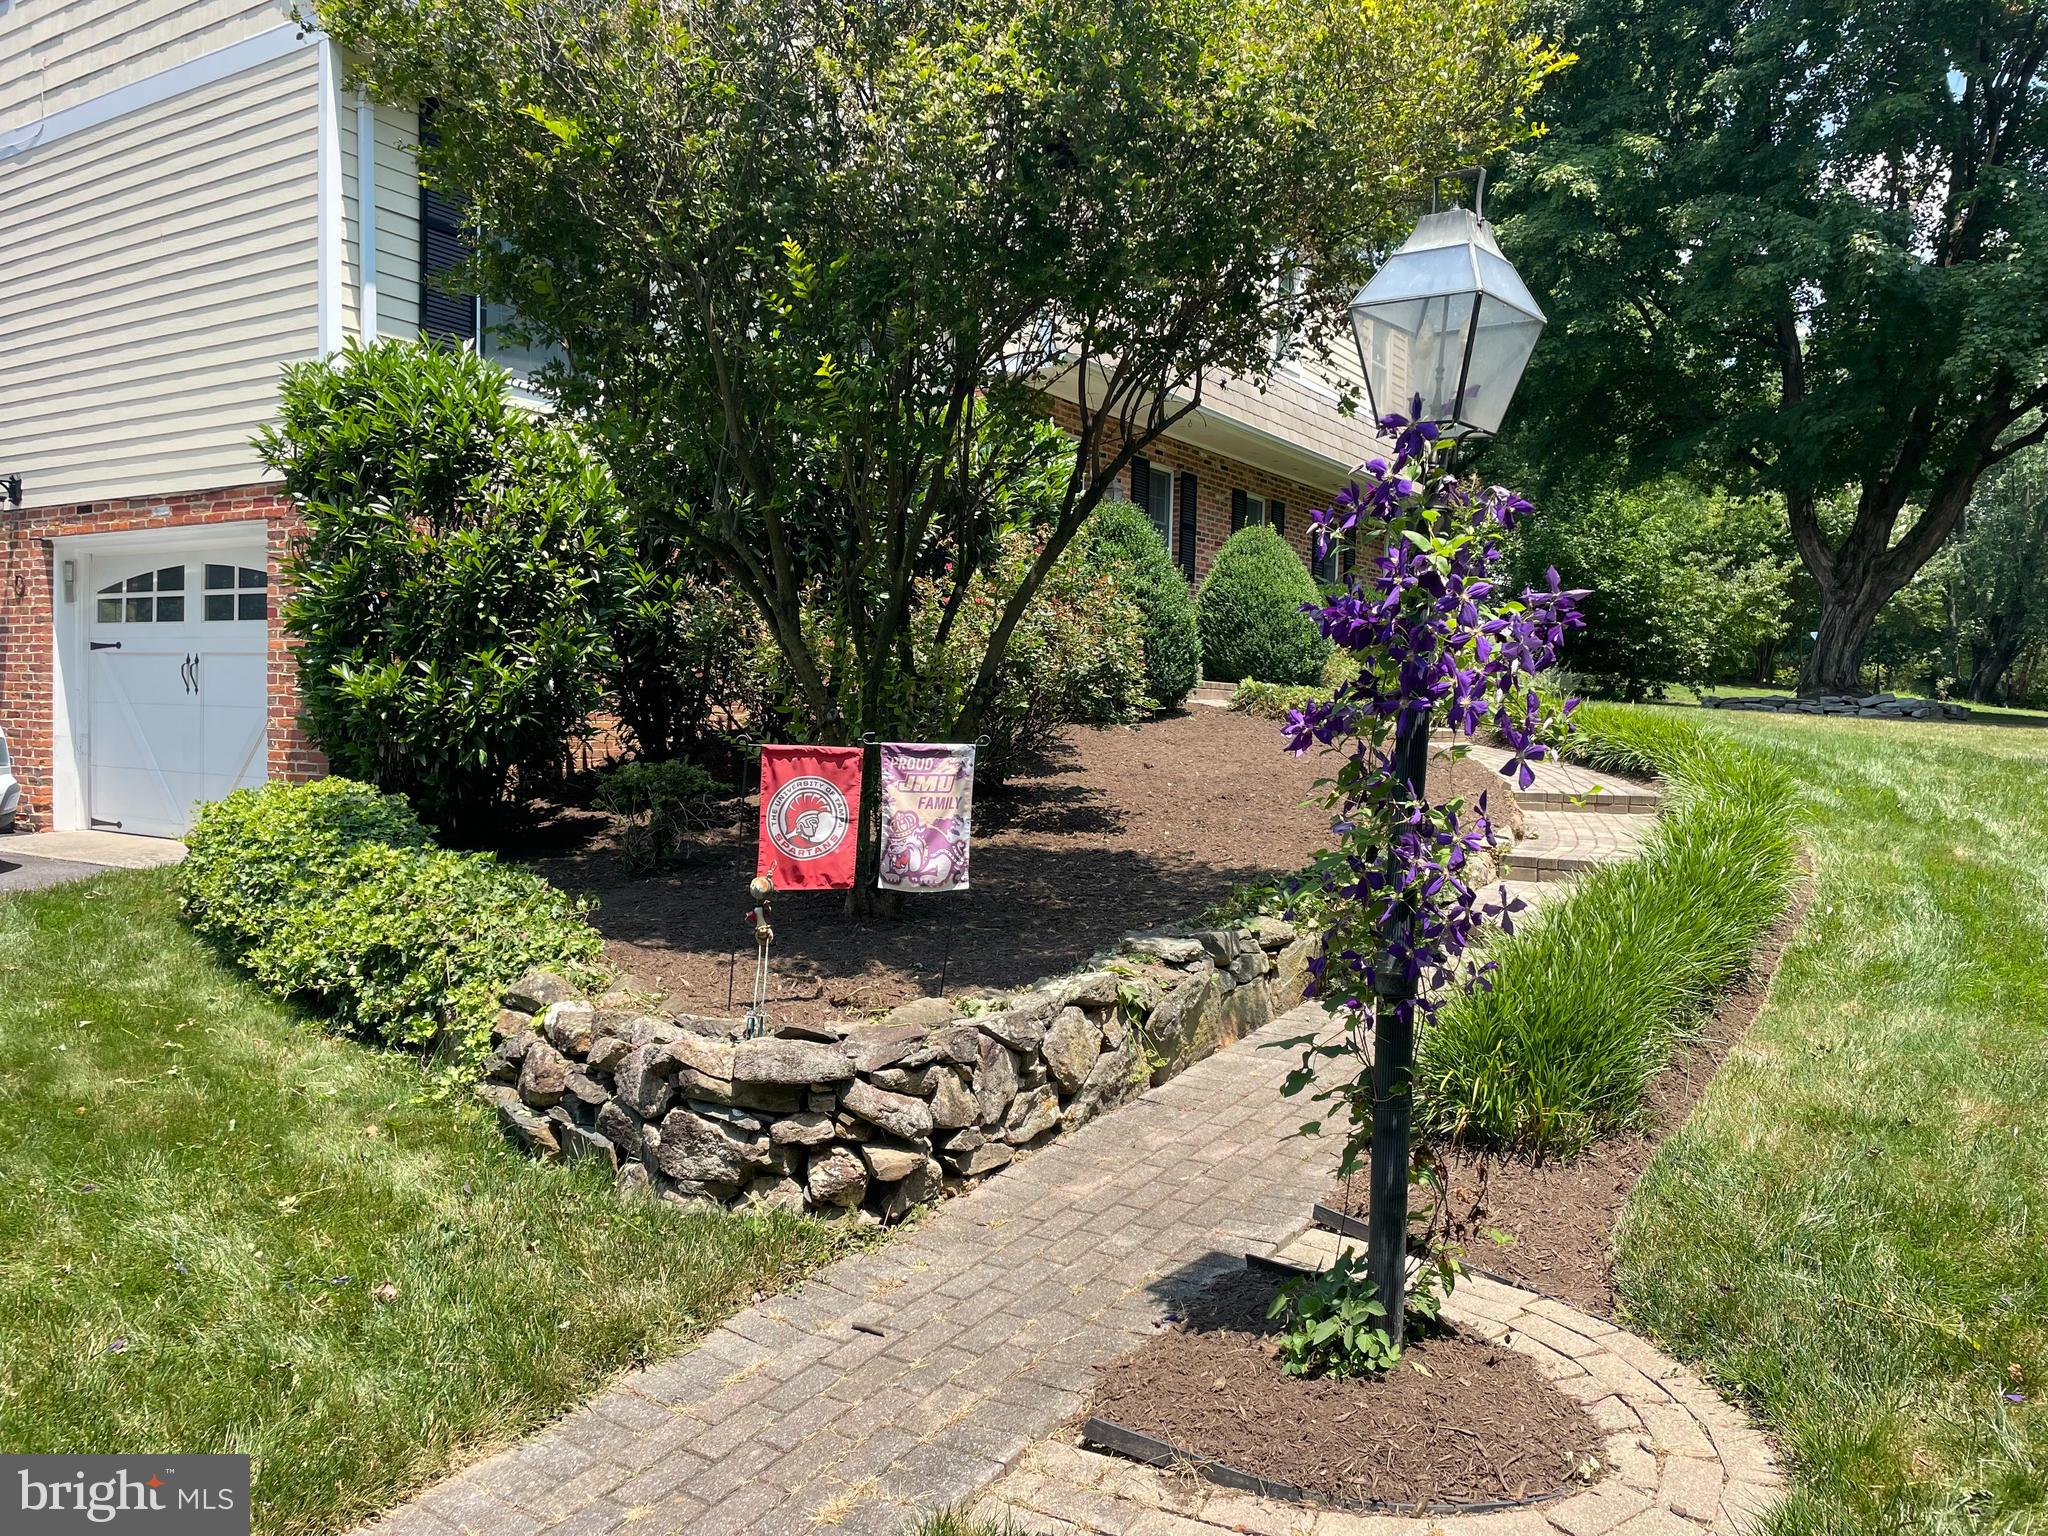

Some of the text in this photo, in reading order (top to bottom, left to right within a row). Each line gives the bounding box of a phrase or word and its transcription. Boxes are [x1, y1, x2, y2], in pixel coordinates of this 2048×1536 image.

[890, 757, 933, 770] PROUD
[898, 773, 955, 793] JMU
[775, 780, 824, 806] UNIVERSITY
[825, 786, 836, 797] OF
[835, 798, 846, 829] TAMPA
[917, 796, 962, 810] FAMILY
[774, 834, 839, 857] SPARTANS
